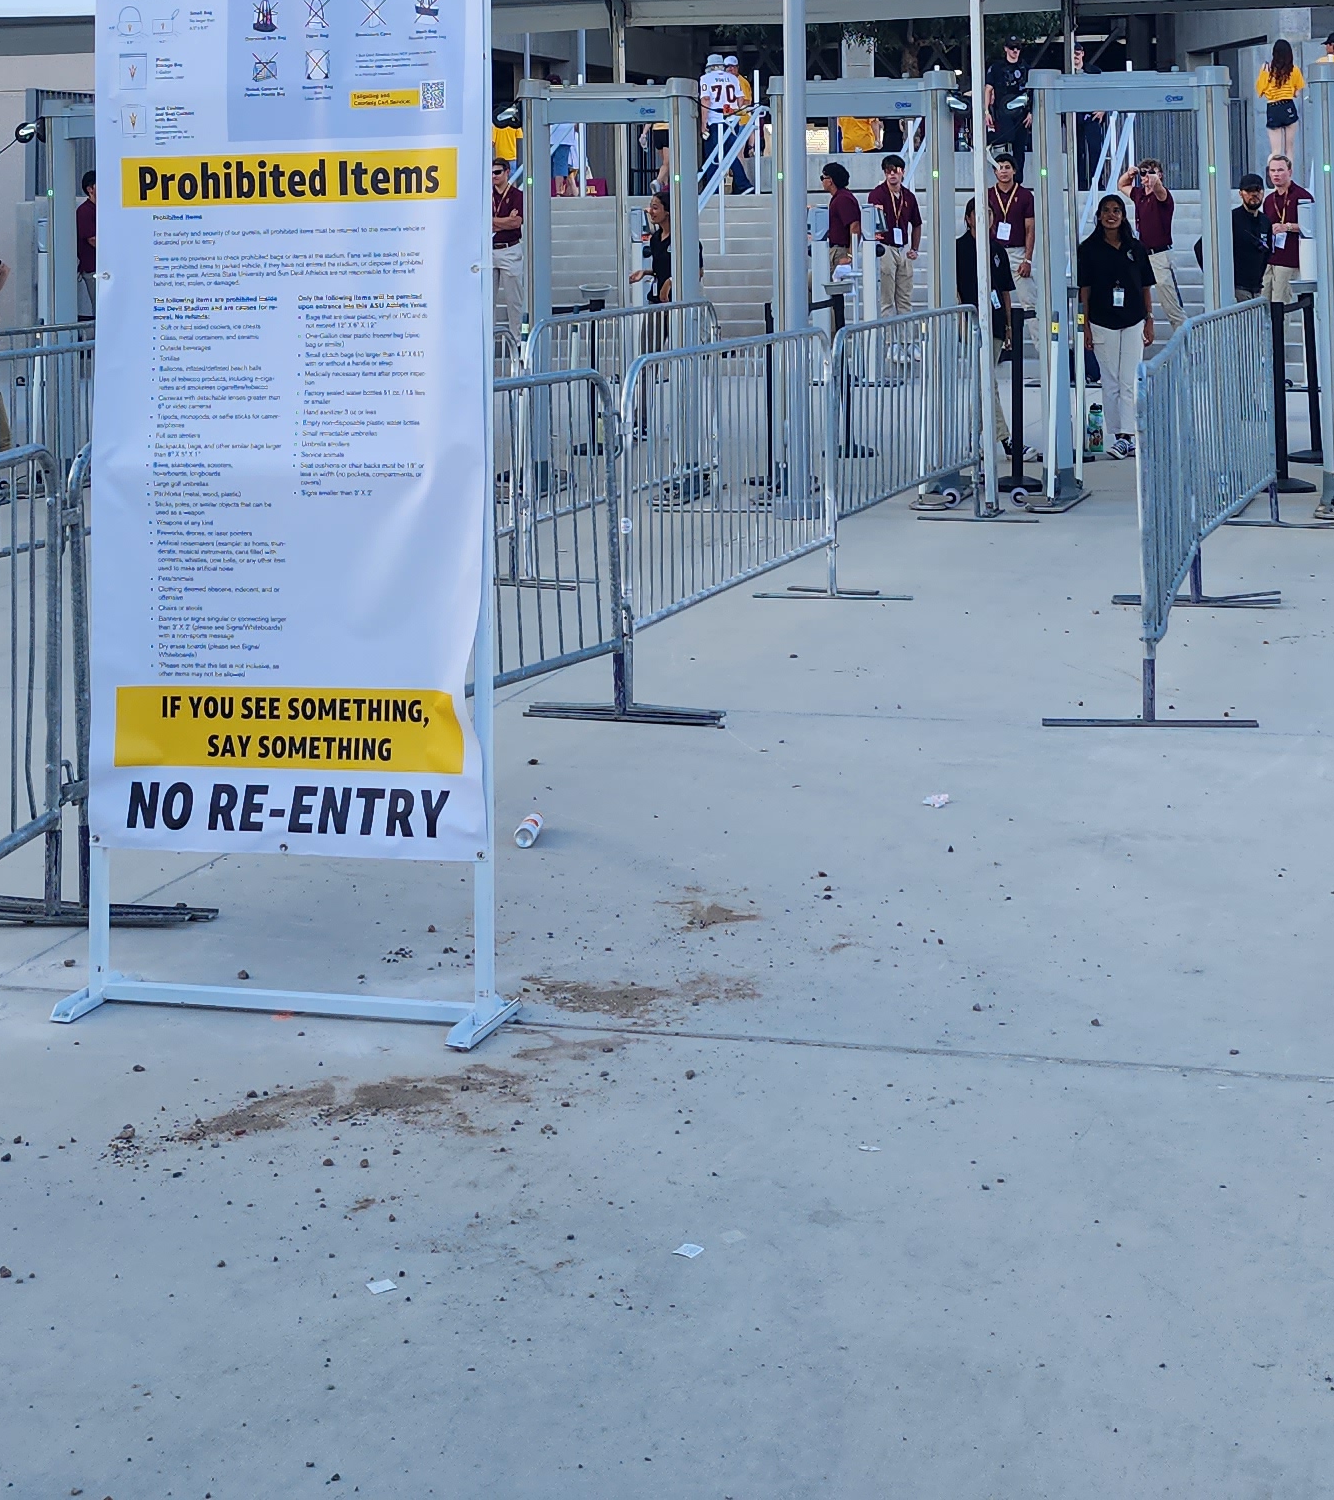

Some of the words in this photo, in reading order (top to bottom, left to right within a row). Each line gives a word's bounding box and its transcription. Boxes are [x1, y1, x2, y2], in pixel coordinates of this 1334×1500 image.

[711, 84, 737, 103] 70
[139, 159, 326, 200] Prohibited
[339, 161, 439, 196] Items
[163, 696, 181, 718] IF
[189, 696, 233, 719] YOU
[241, 697, 280, 719] SEE
[288, 698, 429, 728] SOMETHING,
[208, 735, 251, 757] SAY
[258, 736, 391, 761] SOMETHING
[127, 782, 193, 830] NO
[208, 784, 450, 838] RE-ENTRY
